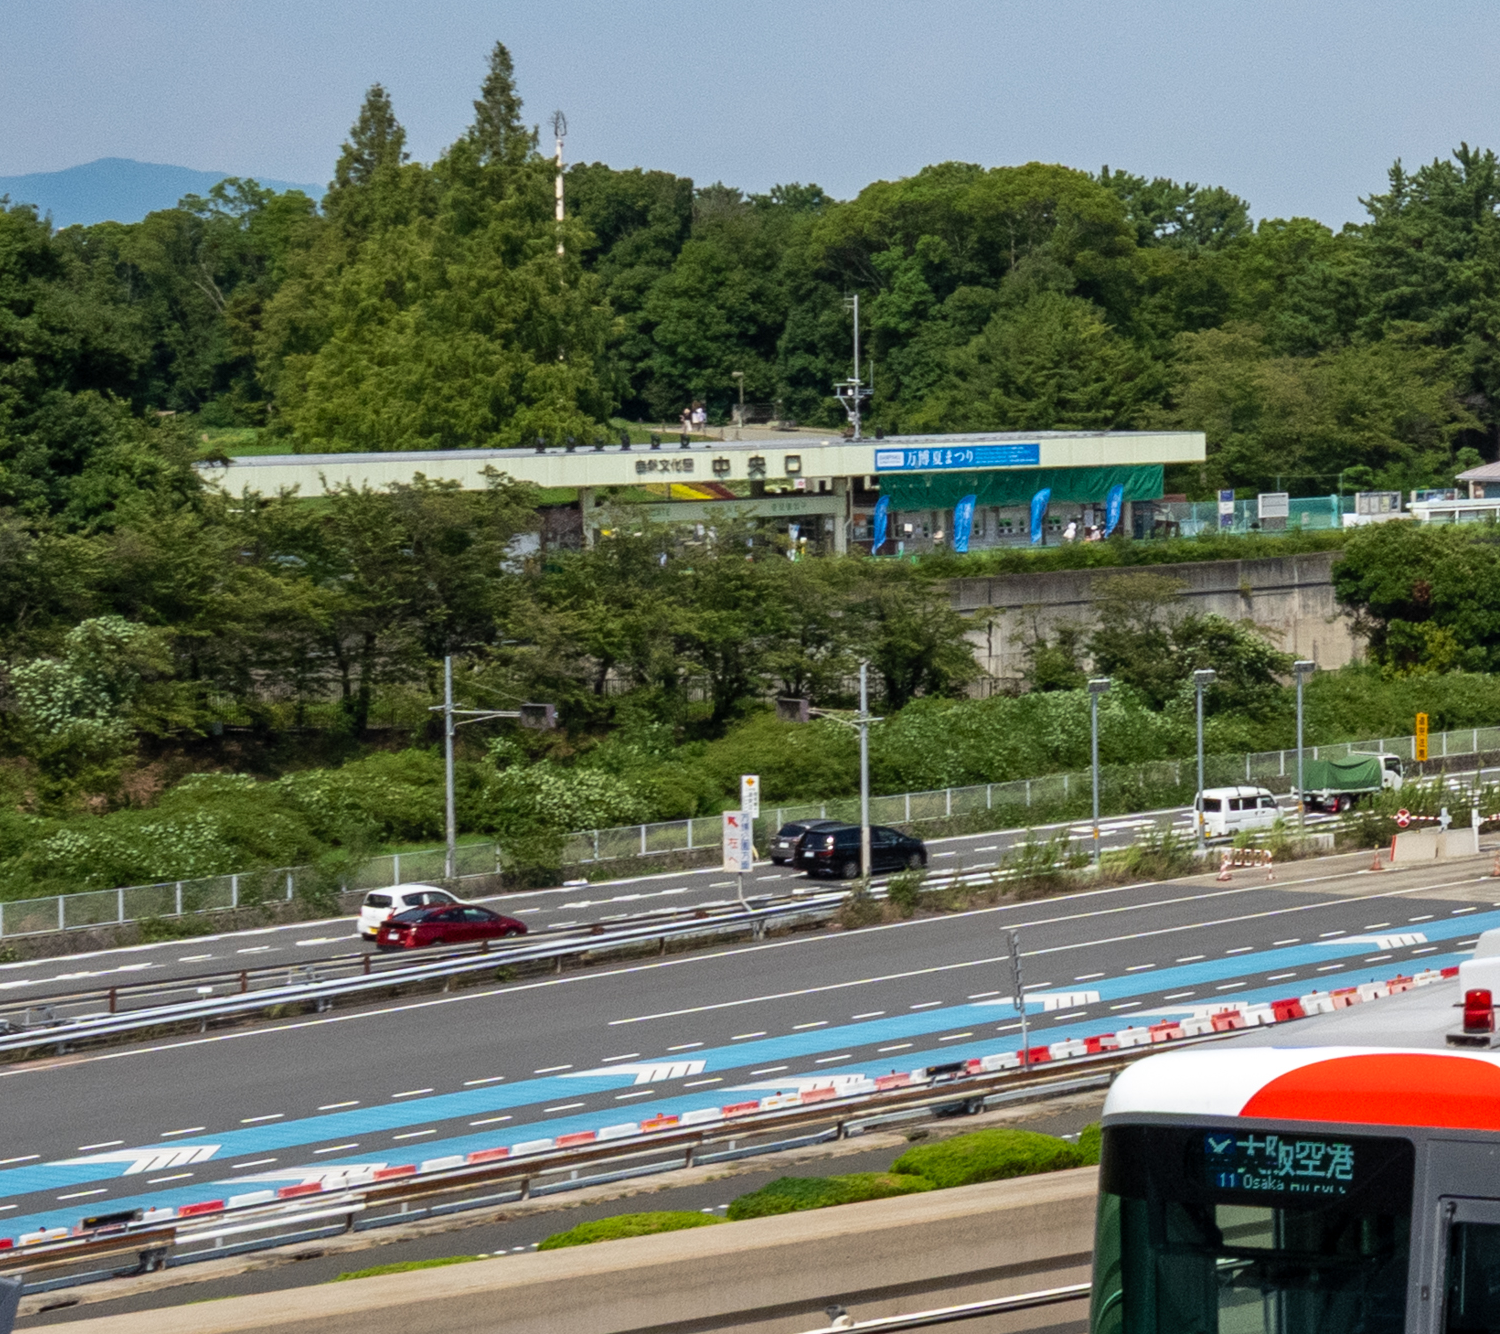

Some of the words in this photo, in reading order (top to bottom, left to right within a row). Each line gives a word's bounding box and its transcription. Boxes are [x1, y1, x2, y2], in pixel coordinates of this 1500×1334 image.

[712, 454, 801, 478] 中央口
[906, 449, 974, 467] 万博夏まつり
[1243, 1174, 1284, 1191] Osaka
